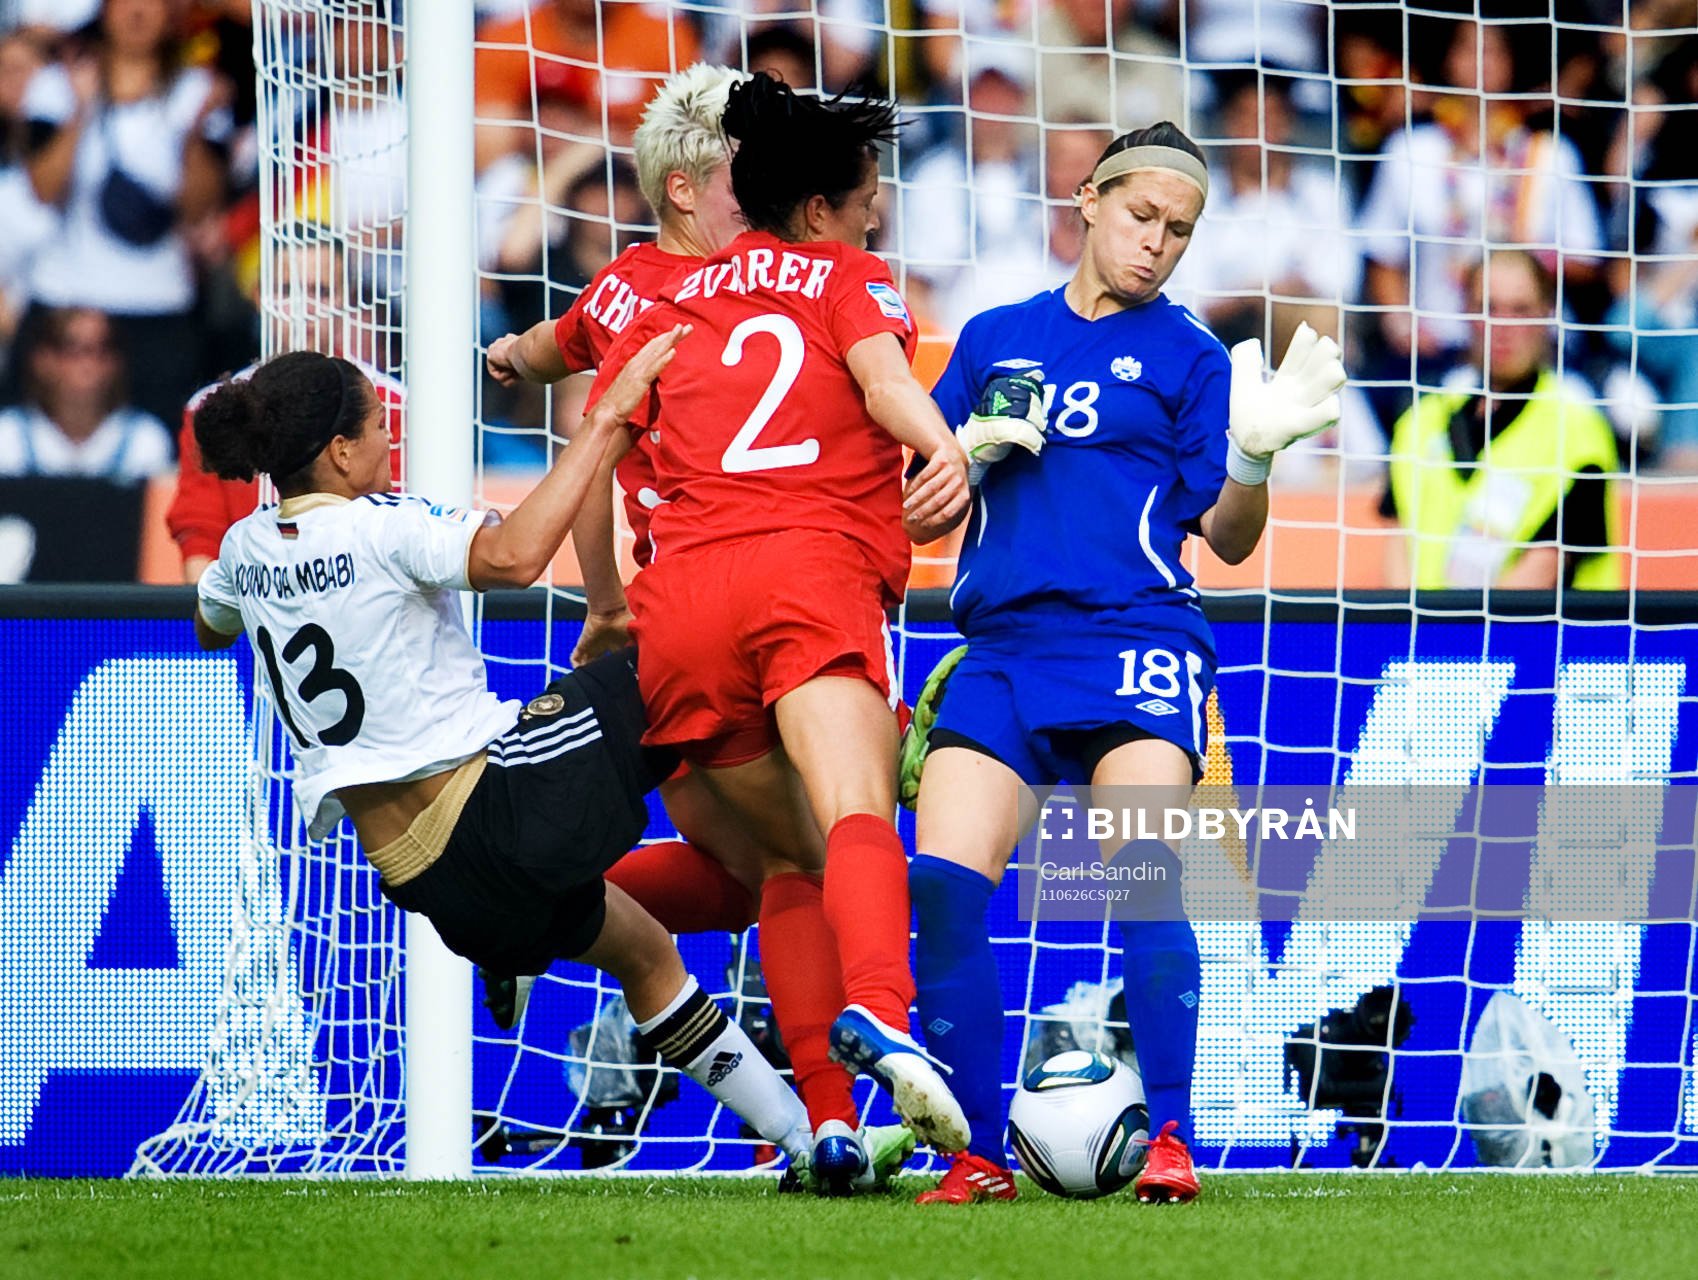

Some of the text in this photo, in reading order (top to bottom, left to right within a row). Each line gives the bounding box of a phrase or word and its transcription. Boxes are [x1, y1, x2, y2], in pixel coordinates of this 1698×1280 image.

[674, 248, 834, 304] ZURRER
[720, 313, 820, 473] 2
[273, 566, 295, 599] DA
[295, 552, 355, 595] MBABI
[256, 622, 366, 749] 13
[1114, 648, 1181, 698] 18
